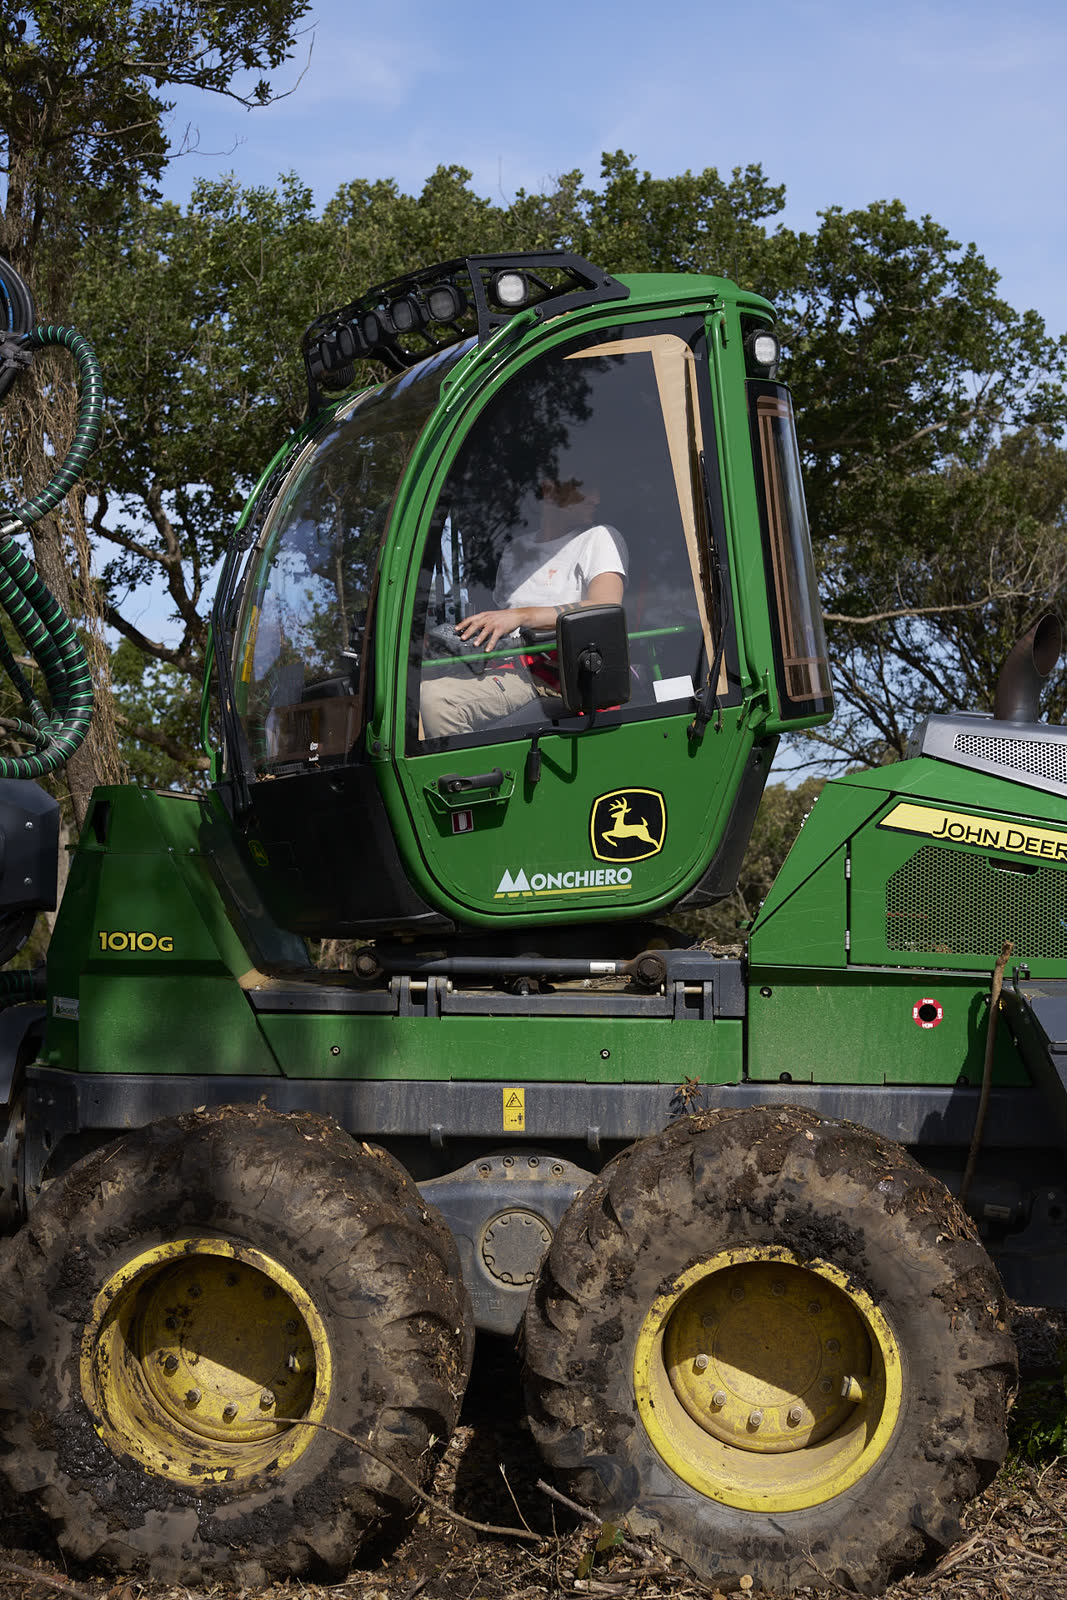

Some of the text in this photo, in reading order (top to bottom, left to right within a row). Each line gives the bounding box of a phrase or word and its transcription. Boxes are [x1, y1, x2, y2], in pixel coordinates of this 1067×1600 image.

[932, 817, 1000, 845] JOHN
[496, 867, 632, 893] MONCHIERO
[98, 931, 174, 952] 1010G
